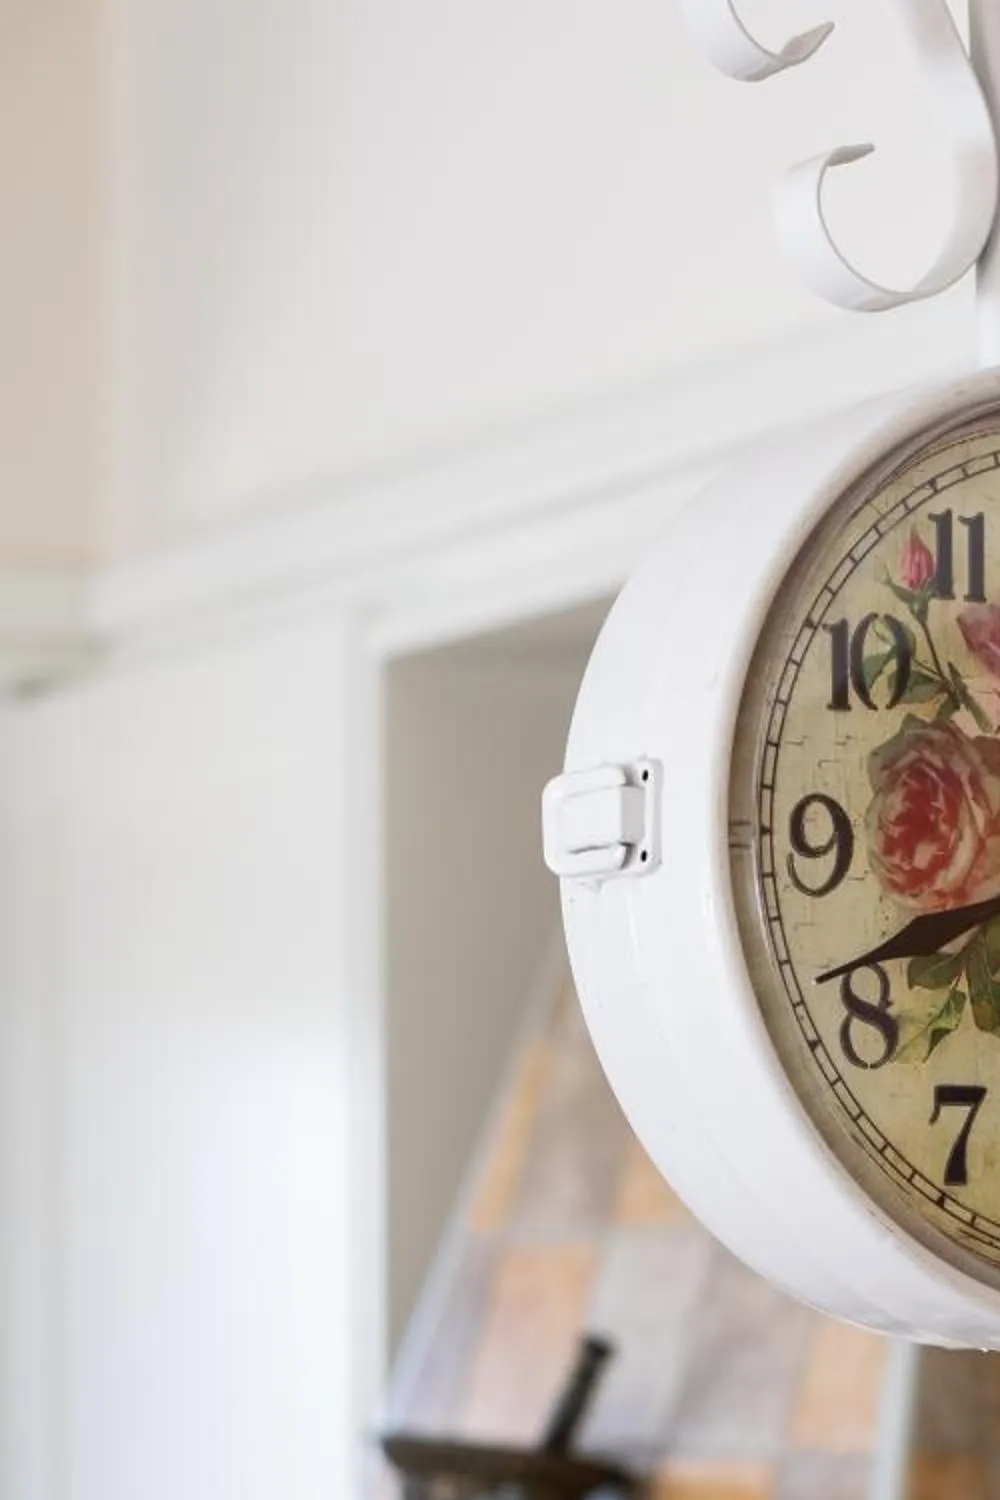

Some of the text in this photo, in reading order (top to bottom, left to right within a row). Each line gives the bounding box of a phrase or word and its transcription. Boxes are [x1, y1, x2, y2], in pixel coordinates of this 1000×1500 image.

[929, 508, 987, 602] 11
[822, 612, 910, 711] 10
[787, 793, 854, 897] 9
[839, 963, 900, 1069] 8
[930, 1085, 988, 1187] 7
